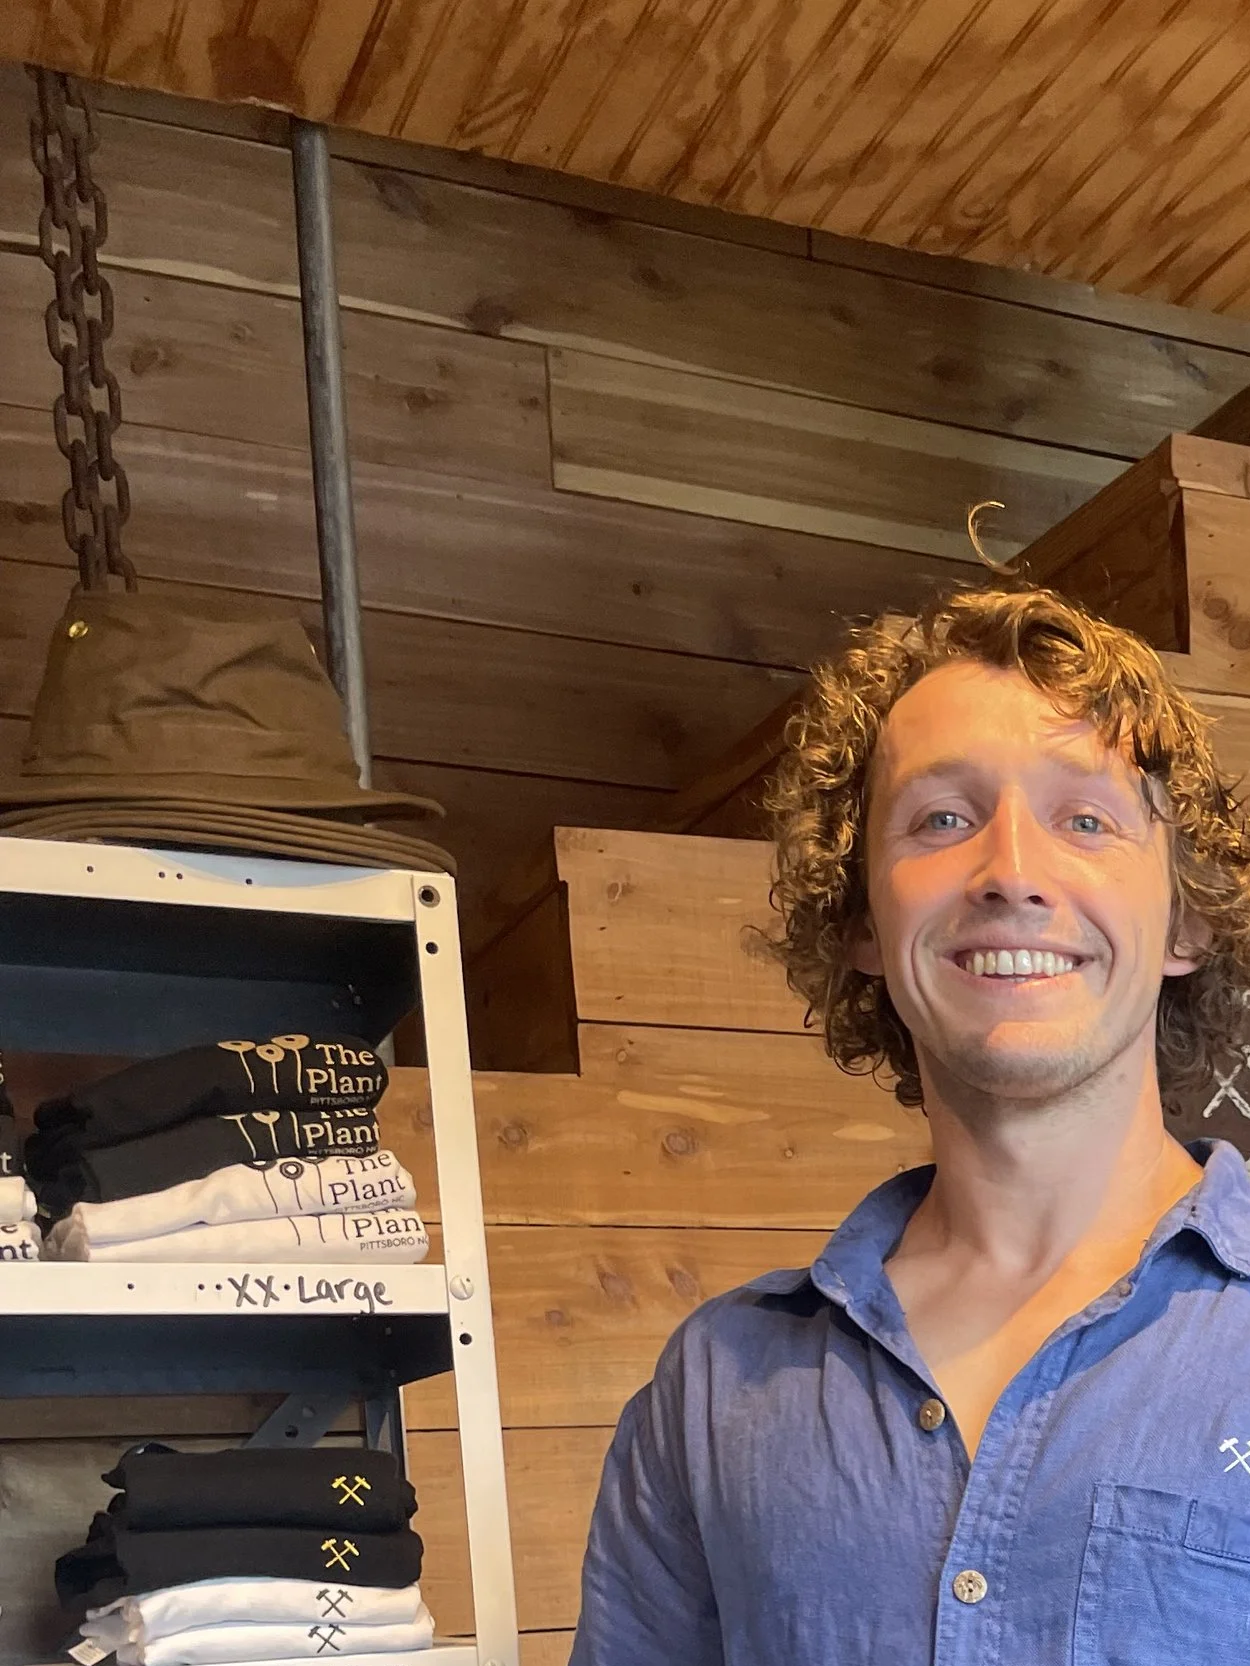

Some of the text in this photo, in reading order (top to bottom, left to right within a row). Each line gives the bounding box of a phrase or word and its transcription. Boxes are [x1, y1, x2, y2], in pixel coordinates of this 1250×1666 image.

[315, 1043, 375, 1066] The
[305, 1068, 383, 1094] Plant
[302, 1121, 380, 1149] Plant
[328, 1176, 406, 1205] Plant
[359, 1236, 415, 1252] PITTSBORO
[299, 1274, 395, 1315] Large
